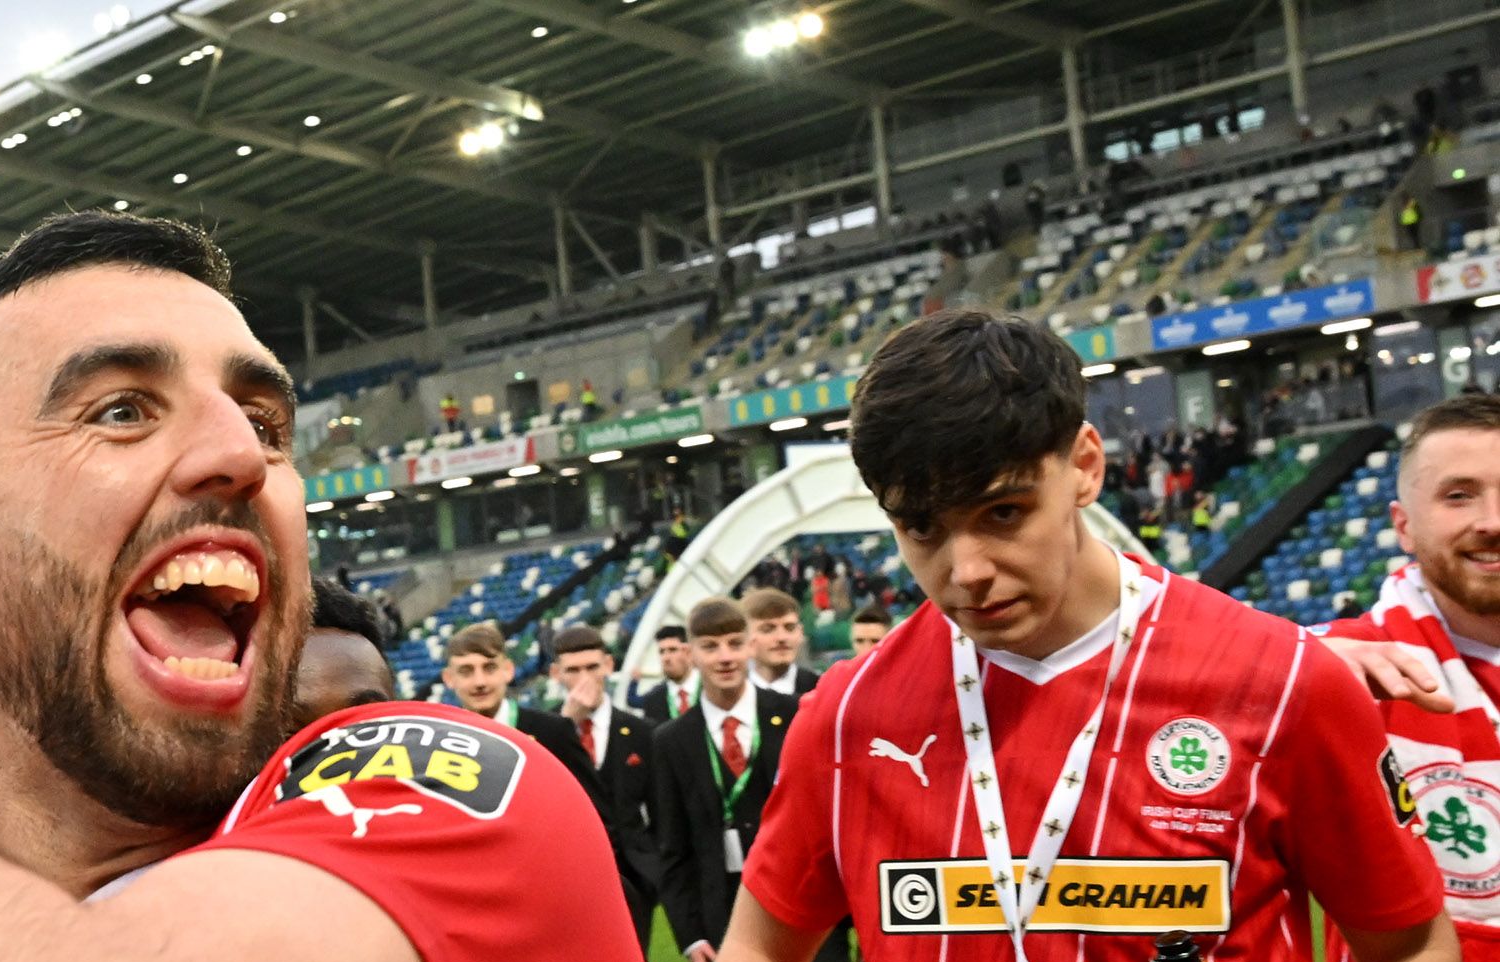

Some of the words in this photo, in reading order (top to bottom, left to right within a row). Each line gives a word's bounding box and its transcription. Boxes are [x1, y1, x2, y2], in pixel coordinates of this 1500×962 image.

[321, 722, 481, 757] fona
[299, 745, 482, 793] CAB
[1173, 807, 1199, 818] CUP
[1200, 808, 1234, 820] FINAL
[956, 883, 1046, 908] SEN
[1058, 882, 1208, 909] GRAHAM
